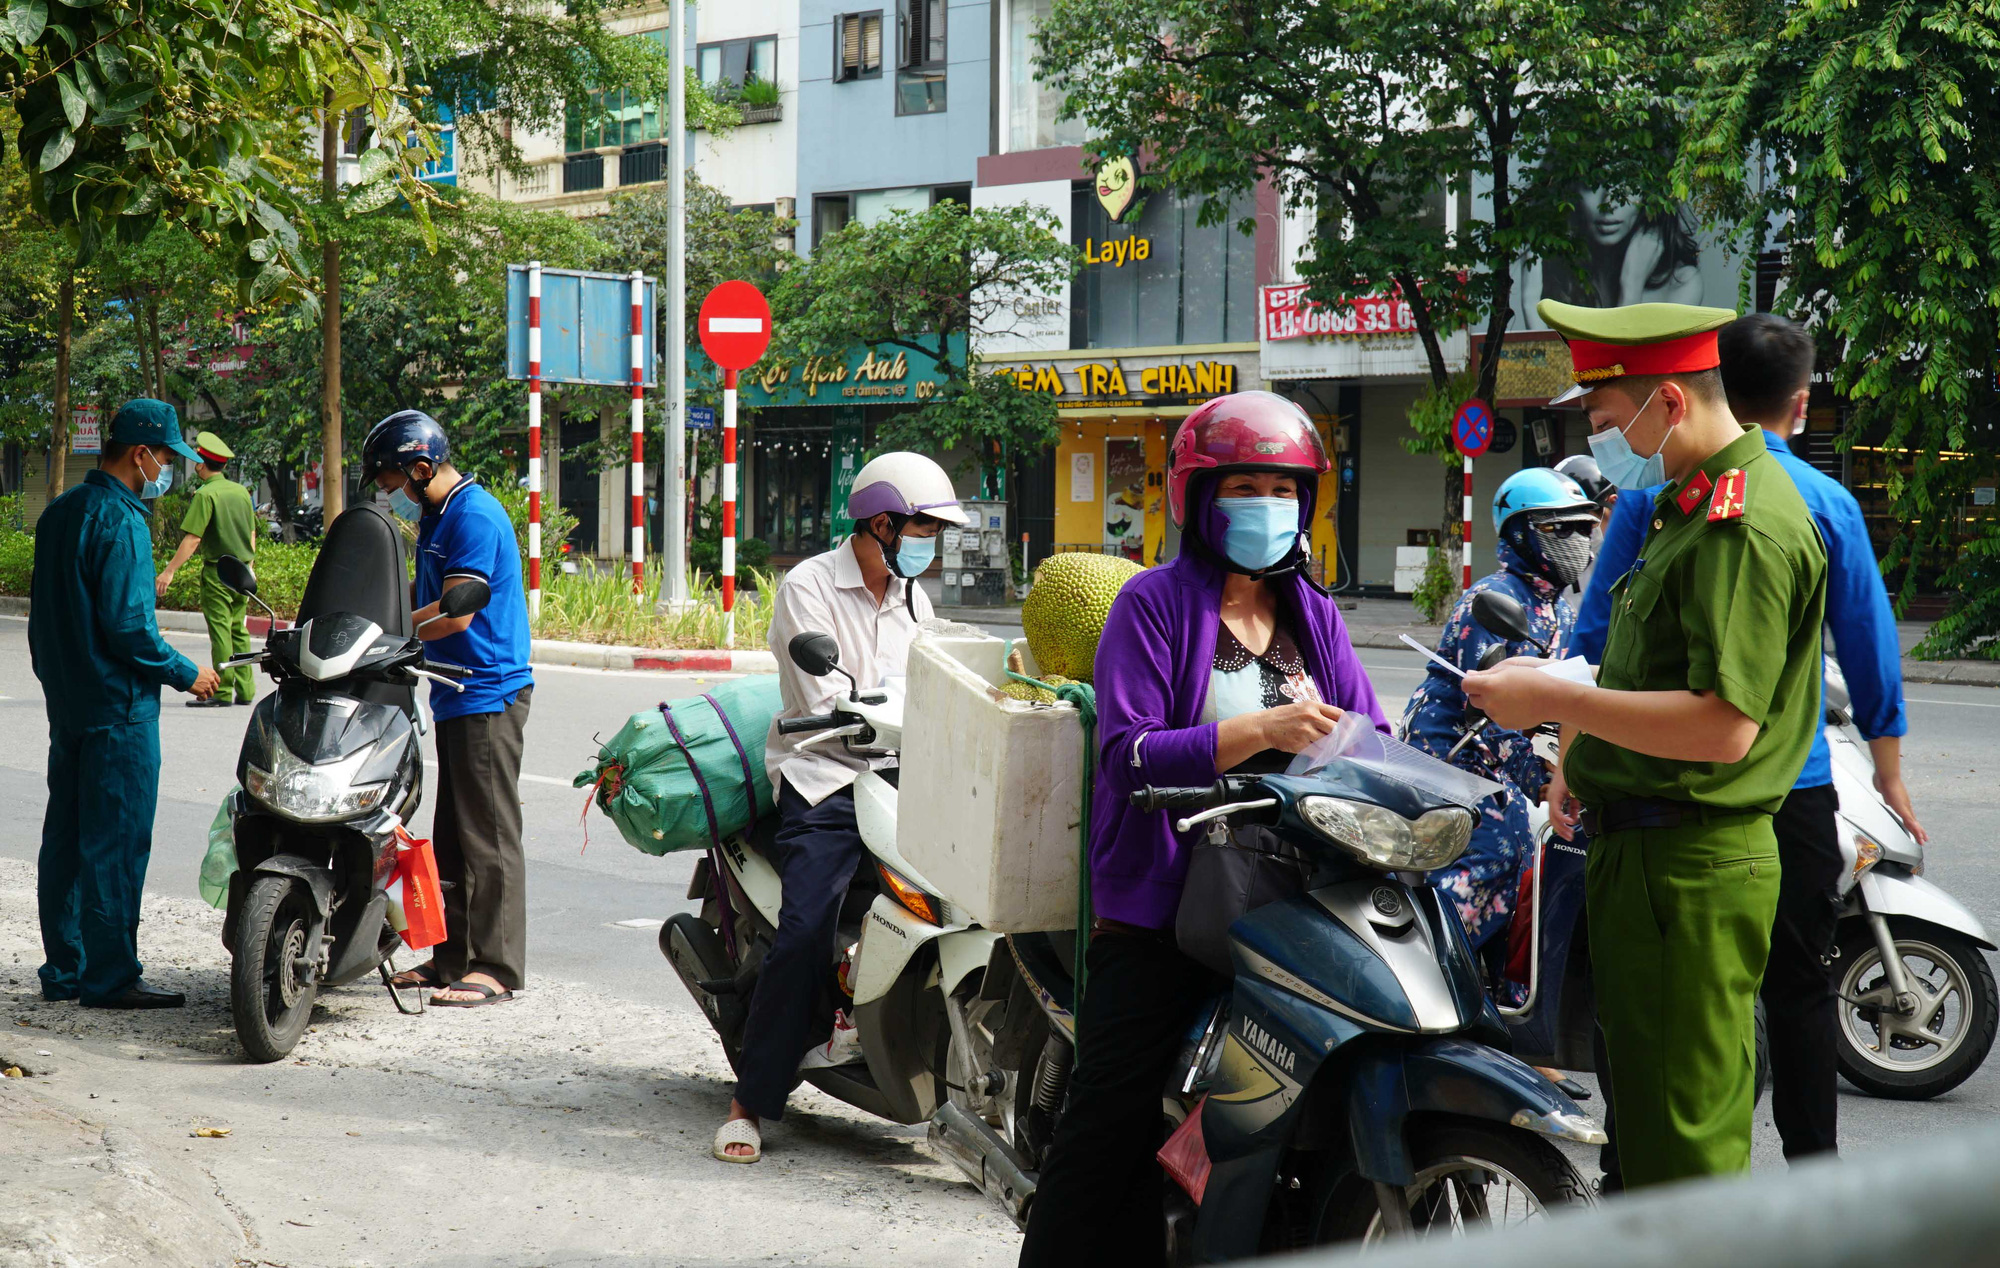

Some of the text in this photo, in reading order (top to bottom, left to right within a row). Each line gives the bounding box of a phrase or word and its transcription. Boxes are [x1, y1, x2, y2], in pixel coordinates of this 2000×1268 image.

[1086, 234, 1149, 267] Layla
[1013, 297, 1062, 316] Center
[1269, 310, 1301, 339] LH:
[1364, 303, 1391, 331] 33
[854, 351, 908, 381] Anh
[1074, 359, 1128, 397] TRÀ
[1141, 360, 1233, 395] CHANH
[1553, 843, 1587, 856] HONDA
[872, 911, 907, 939] HONDA
[1242, 1015, 1296, 1074] YAMAHA
